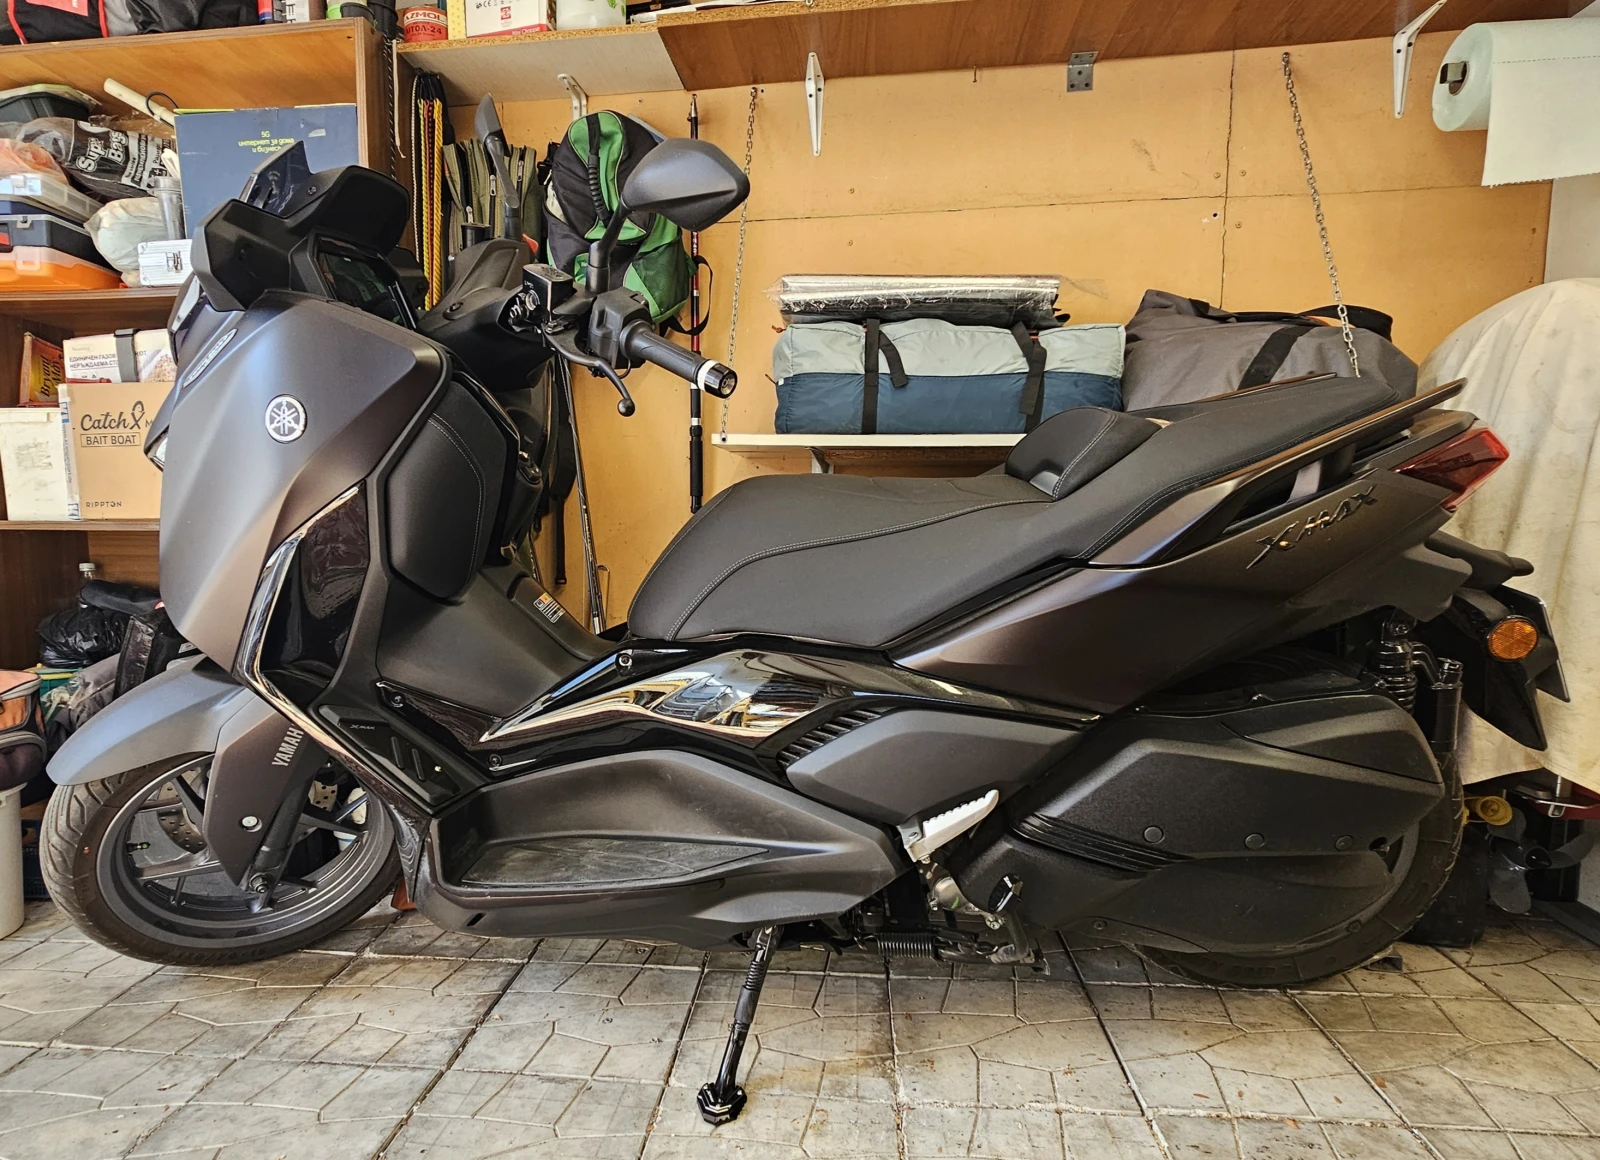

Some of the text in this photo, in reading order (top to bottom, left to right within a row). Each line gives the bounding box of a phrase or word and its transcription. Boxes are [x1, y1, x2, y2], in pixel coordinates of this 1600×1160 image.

[261, 130, 271, 138] 5G
[69, 353, 98, 363] ЕДИНИЧЕН
[98, 352, 117, 360] ГАЗОВ
[86, 434, 136, 445] BAIT BOAT
[86, 501, 122, 509] RIPPTON
[272, 722, 304, 767] YAMAH
